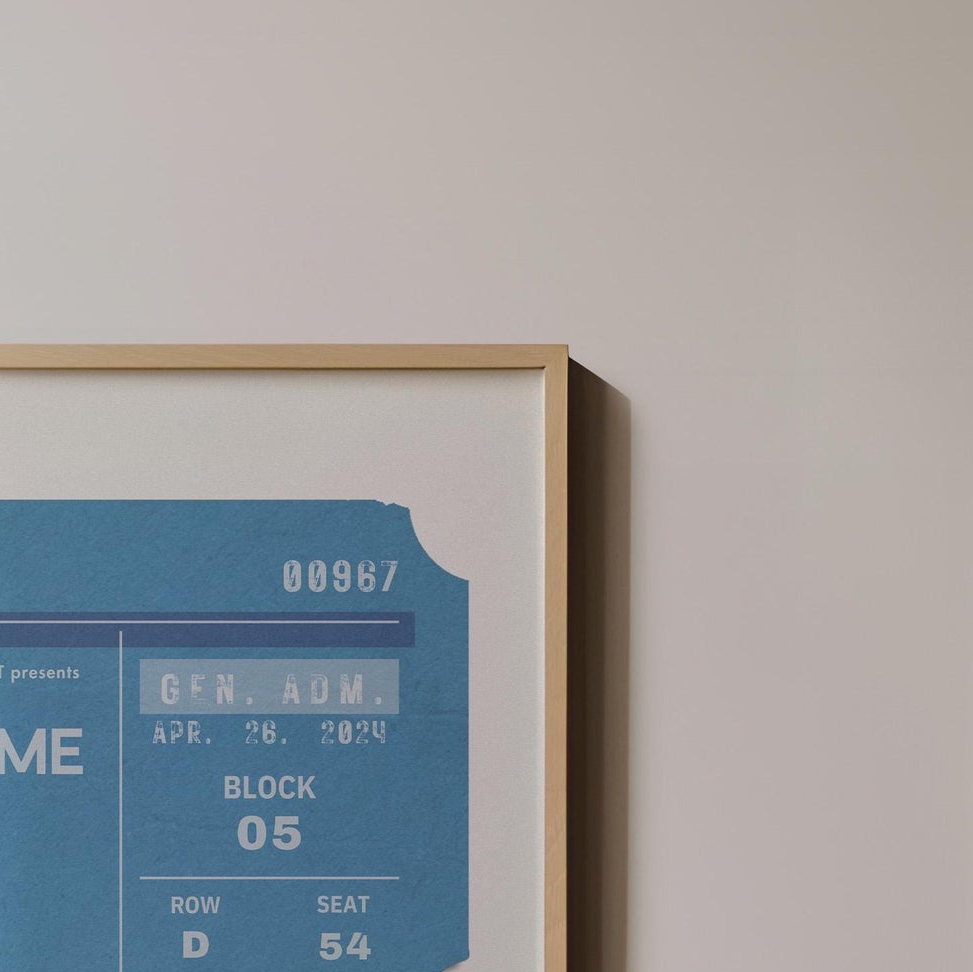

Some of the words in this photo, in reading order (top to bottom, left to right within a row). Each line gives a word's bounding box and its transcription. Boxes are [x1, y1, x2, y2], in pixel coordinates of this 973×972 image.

[284, 560, 397, 592] 00967
[11, 667, 79, 683] presents
[161, 674, 252, 704] GEN.
[283, 674, 381, 704] ADM.
[153, 721, 210, 744] APR.
[246, 720, 286, 744] 26.
[322, 720, 385, 744] 2024
[225, 776, 315, 799] BLOCK
[238, 816, 301, 850] 05
[171, 896, 220, 914] ROW
[317, 896, 369, 913] SEAT
[183, 931, 209, 958] D
[320, 932, 371, 960] 54
